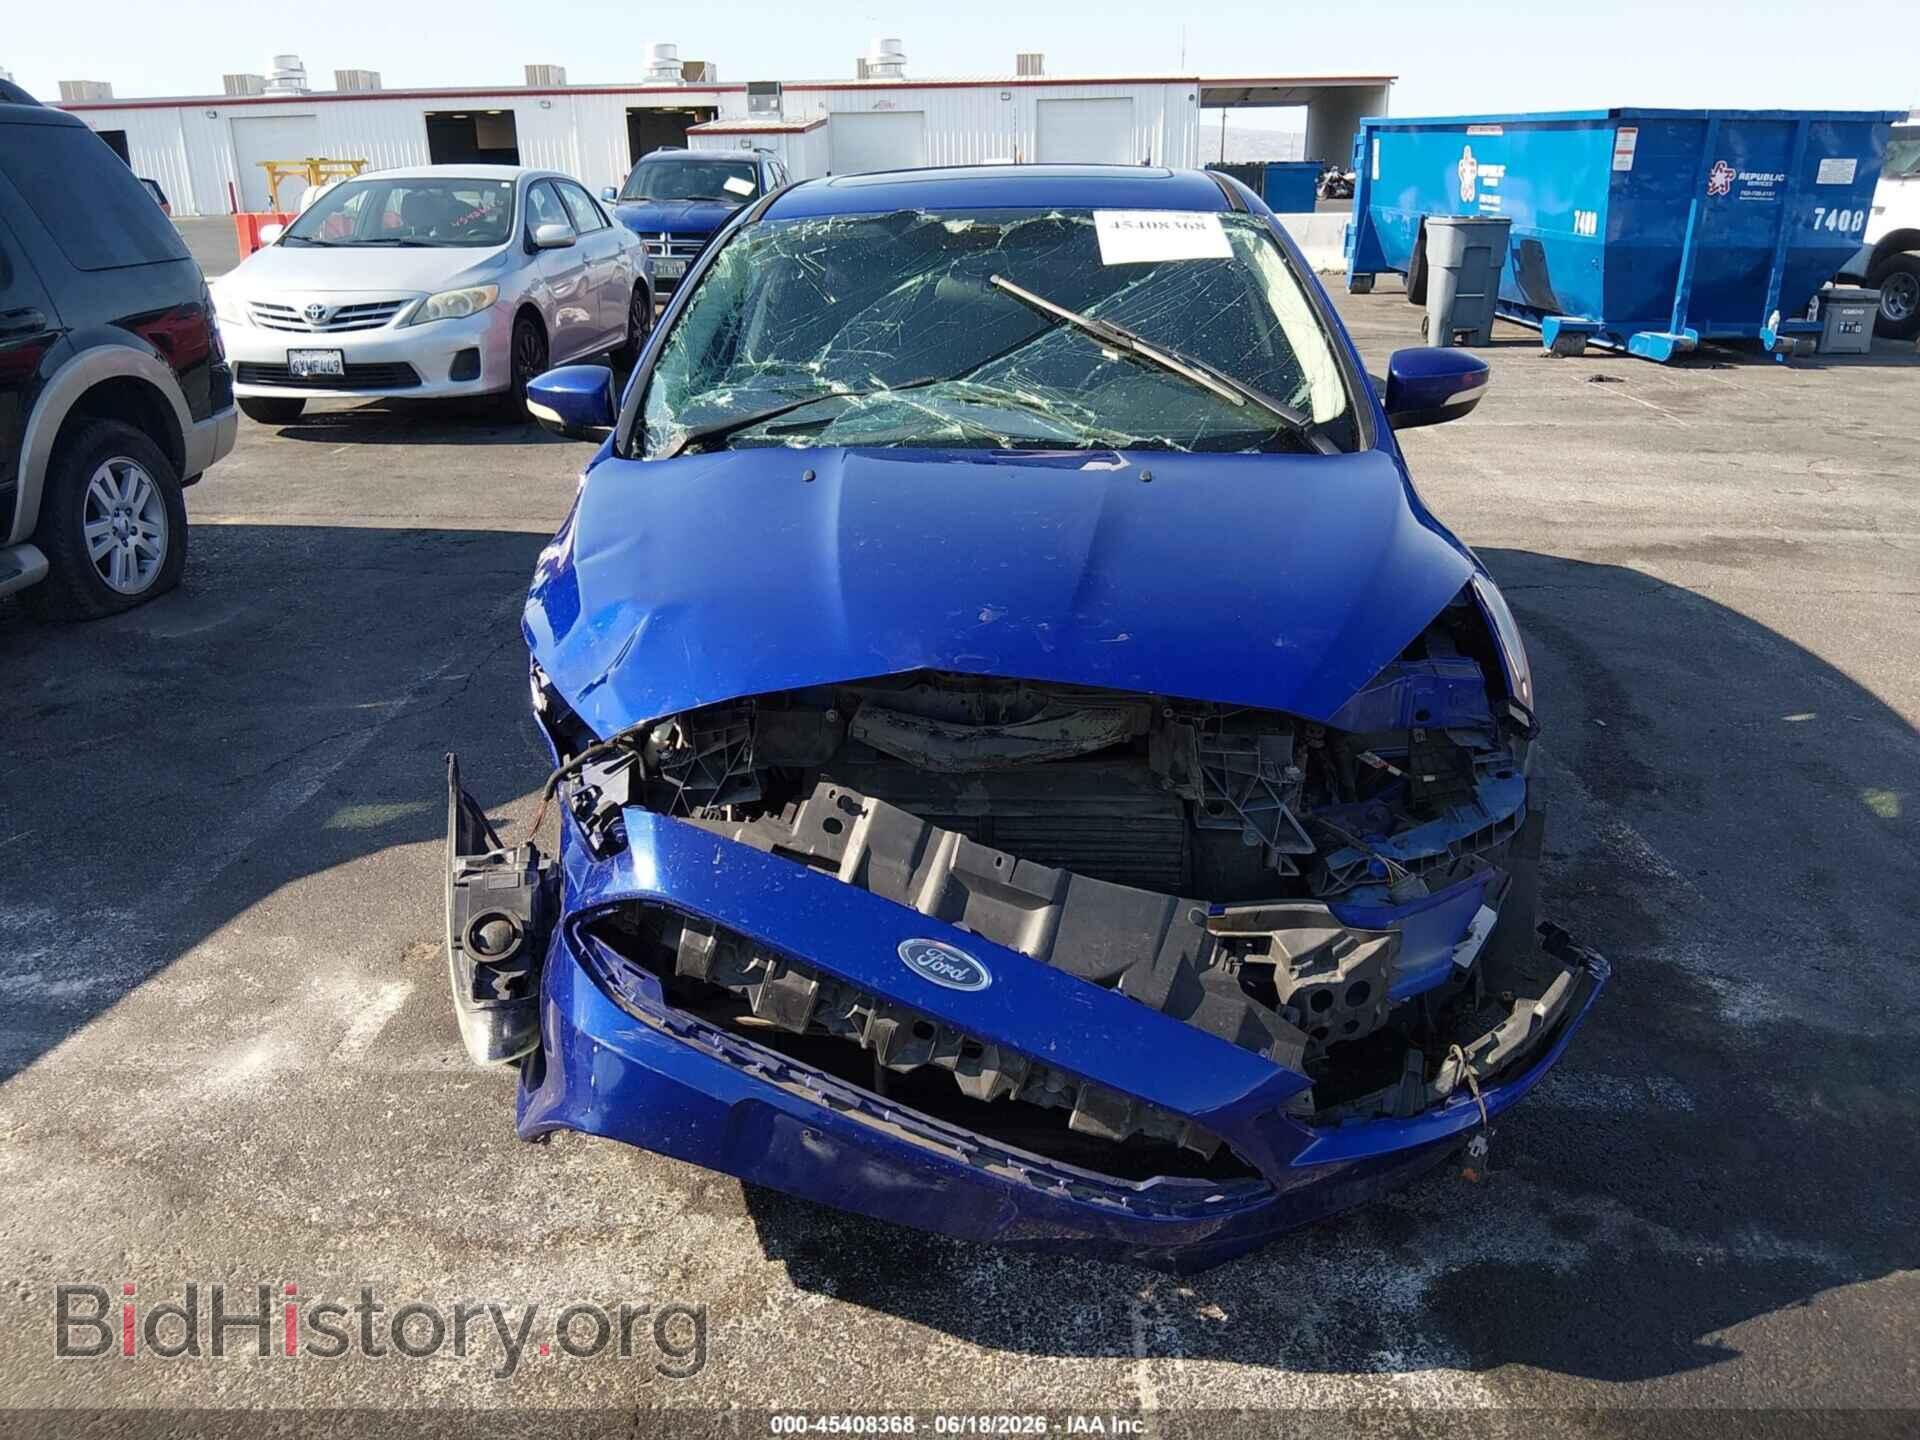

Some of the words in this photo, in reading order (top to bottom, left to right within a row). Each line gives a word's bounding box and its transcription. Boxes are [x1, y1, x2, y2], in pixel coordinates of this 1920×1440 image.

[1738, 173, 1785, 182] REPUBLIC
[1814, 207, 1864, 231] 7408
[916, 948, 971, 981] Ford
